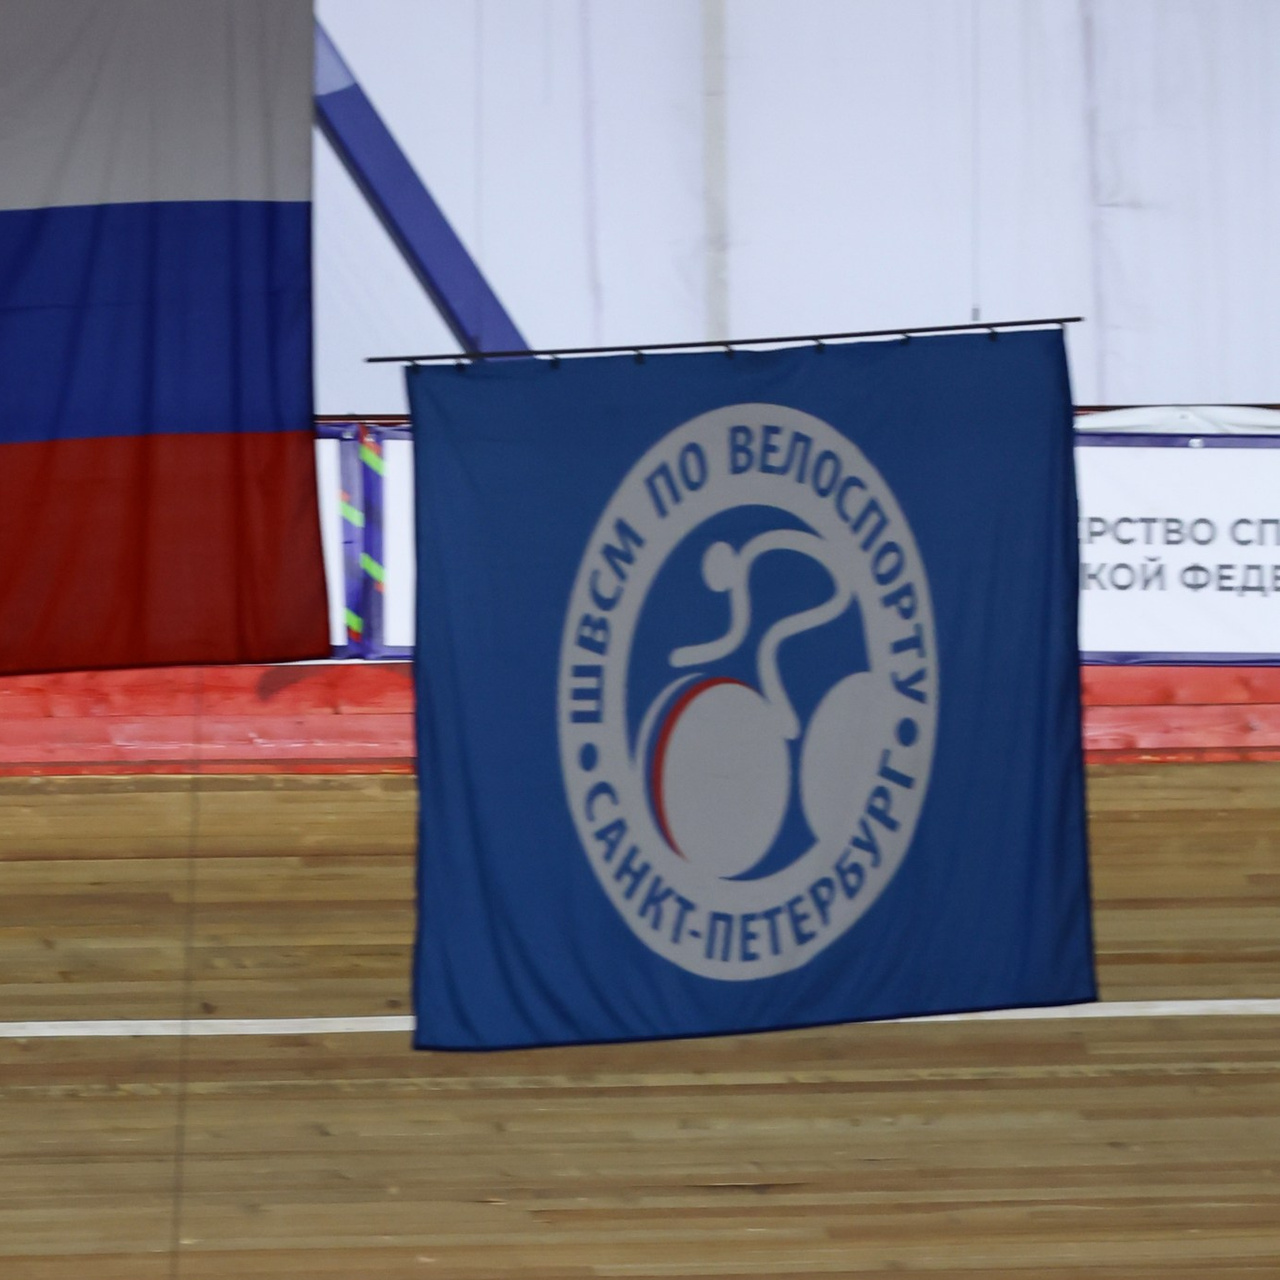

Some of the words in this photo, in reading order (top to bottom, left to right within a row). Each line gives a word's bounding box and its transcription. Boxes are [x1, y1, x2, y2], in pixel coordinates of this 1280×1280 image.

[570, 517, 646, 723] ШВСМ
[644, 442, 709, 518] ПО
[728, 425, 927, 703] ВЕЛОСПОРТУ
[584, 749, 915, 963] САНКТ-ПЕТЕРБУРГ
